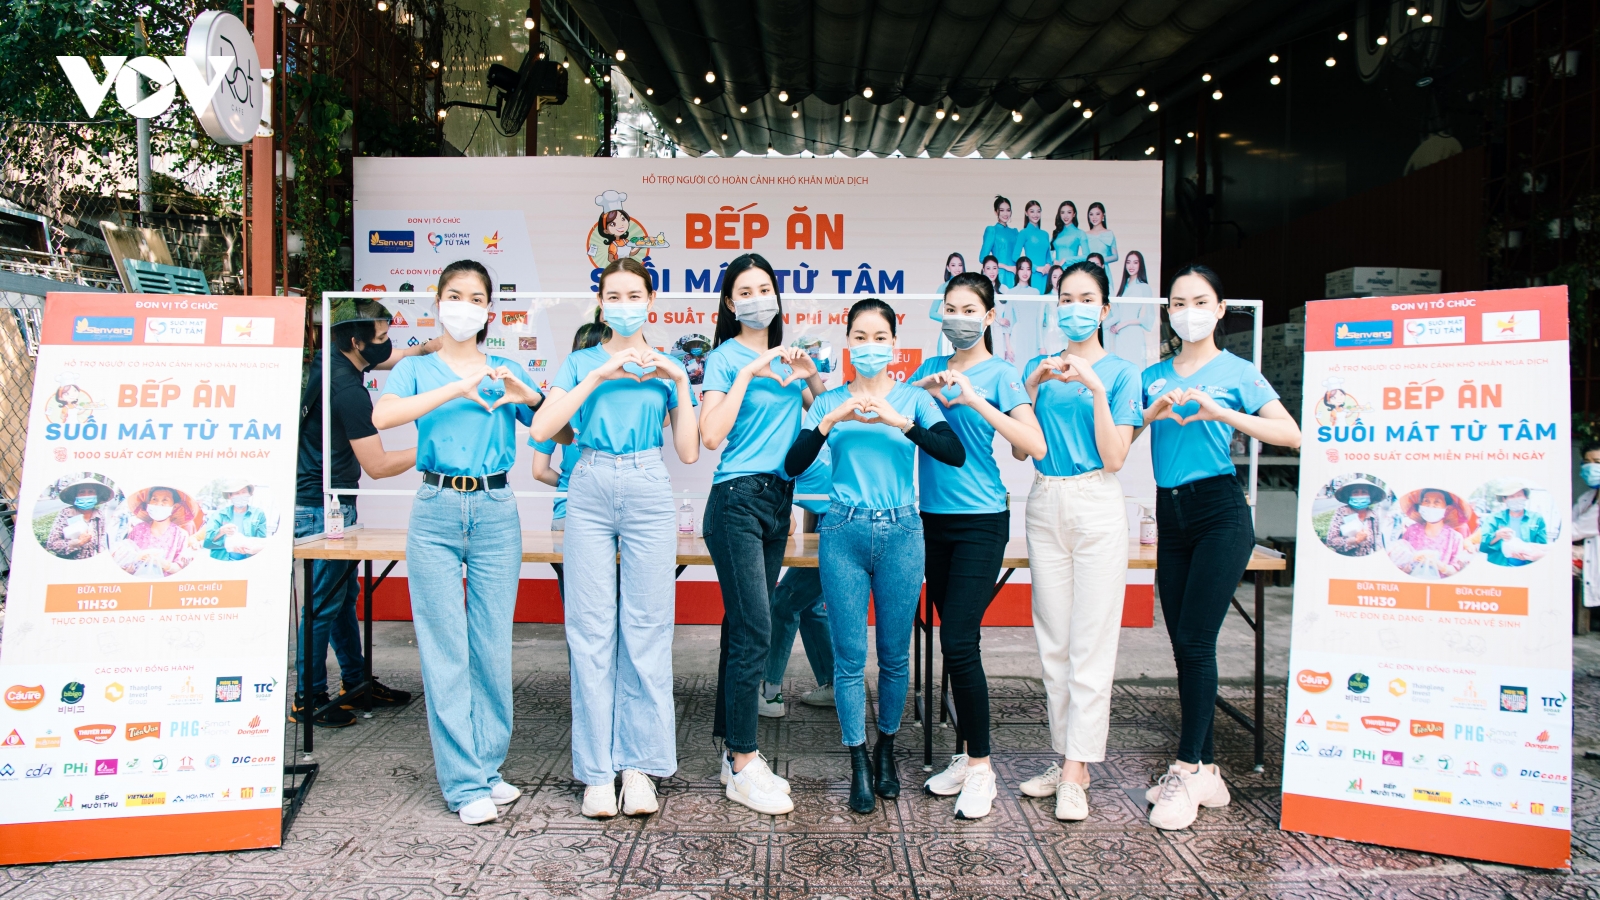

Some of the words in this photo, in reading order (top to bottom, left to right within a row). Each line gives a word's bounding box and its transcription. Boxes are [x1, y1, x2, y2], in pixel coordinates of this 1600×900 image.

[642, 173, 656, 184] HỖ
[657, 175, 675, 186] TRỢ
[676, 175, 706, 184] NGƯỜI
[707, 174, 720, 184] CÓ
[722, 174, 748, 184] HOÀN
[749, 174, 775, 185] CẢNH
[777, 175, 796, 185] KHÓ
[798, 174, 823, 185] KHĂN
[824, 175, 845, 185] MÙA
[847, 176, 869, 186] DỊCH
[685, 202, 770, 250] BẾP
[786, 205, 844, 250] ĂN
[773, 262, 819, 294] TỪ
[831, 262, 905, 294] TÂM
[135, 301, 159, 309] ĐƠN
[161, 301, 172, 310] VỊ
[174, 300, 189, 310] TỔ
[190, 301, 219, 310] CHỨC
[1391, 303, 1415, 311] ĐƠN
[1418, 302, 1428, 311] VỊ
[1430, 298, 1445, 309] TỔ
[1447, 298, 1476, 308] CHỨC
[663, 307, 705, 324] SUẤT
[796, 310, 822, 325] PHÍ
[117, 377, 181, 409] BẾP
[192, 379, 237, 409] ĂN
[1382, 379, 1445, 410] BẾP
[1458, 379, 1503, 409] ĂN
[45, 415, 108, 441] SUỐI
[118, 418, 174, 441] MÁT
[183, 418, 220, 441] TỪ
[229, 418, 282, 441] TÂM
[1317, 417, 1375, 443] SUỐI
[1386, 420, 1440, 442] MÁT
[1450, 419, 1487, 442] TỪ
[1498, 418, 1557, 441] TÂM
[73, 451, 101, 460] 1000
[104, 447, 134, 460] SUẤT
[138, 450, 162, 459] CƠM
[165, 447, 193, 459] MIỄN
[196, 448, 214, 459] PHÍ
[218, 447, 238, 459] MỖI
[240, 448, 271, 459] NGÀY
[1344, 452, 1371, 461] 1000
[1373, 449, 1402, 461] SUẤT
[1405, 451, 1432, 460] CƠM
[1433, 449, 1462, 461] MIỄN
[1465, 450, 1484, 460] PHÍ
[1488, 448, 1509, 461] MỖI
[1512, 450, 1546, 460] NGÀY
[77, 585, 96, 595] BỮA
[98, 585, 122, 594] TRƯA
[178, 583, 197, 592] BỮA
[197, 583, 223, 592] CHIỀU
[1356, 582, 1375, 591] BỮA
[1376, 583, 1400, 592] TRƯA
[1455, 587, 1474, 596] BỮA
[77, 599, 118, 610] 11H30
[180, 596, 219, 606] 17H00
[1357, 595, 1397, 608] 11H30
[1457, 600, 1499, 611] 17H00
[102, 616, 116, 624] ĐA
[159, 614, 173, 622] AN
[218, 613, 239, 621] SINH
[1438, 616, 1452, 624] AN
[1497, 619, 1521, 628] SINH
[254, 683, 273, 693] TTC
[1541, 696, 1563, 708] TTC
[170, 720, 200, 738] PHG
[1454, 724, 1485, 742] PHG
